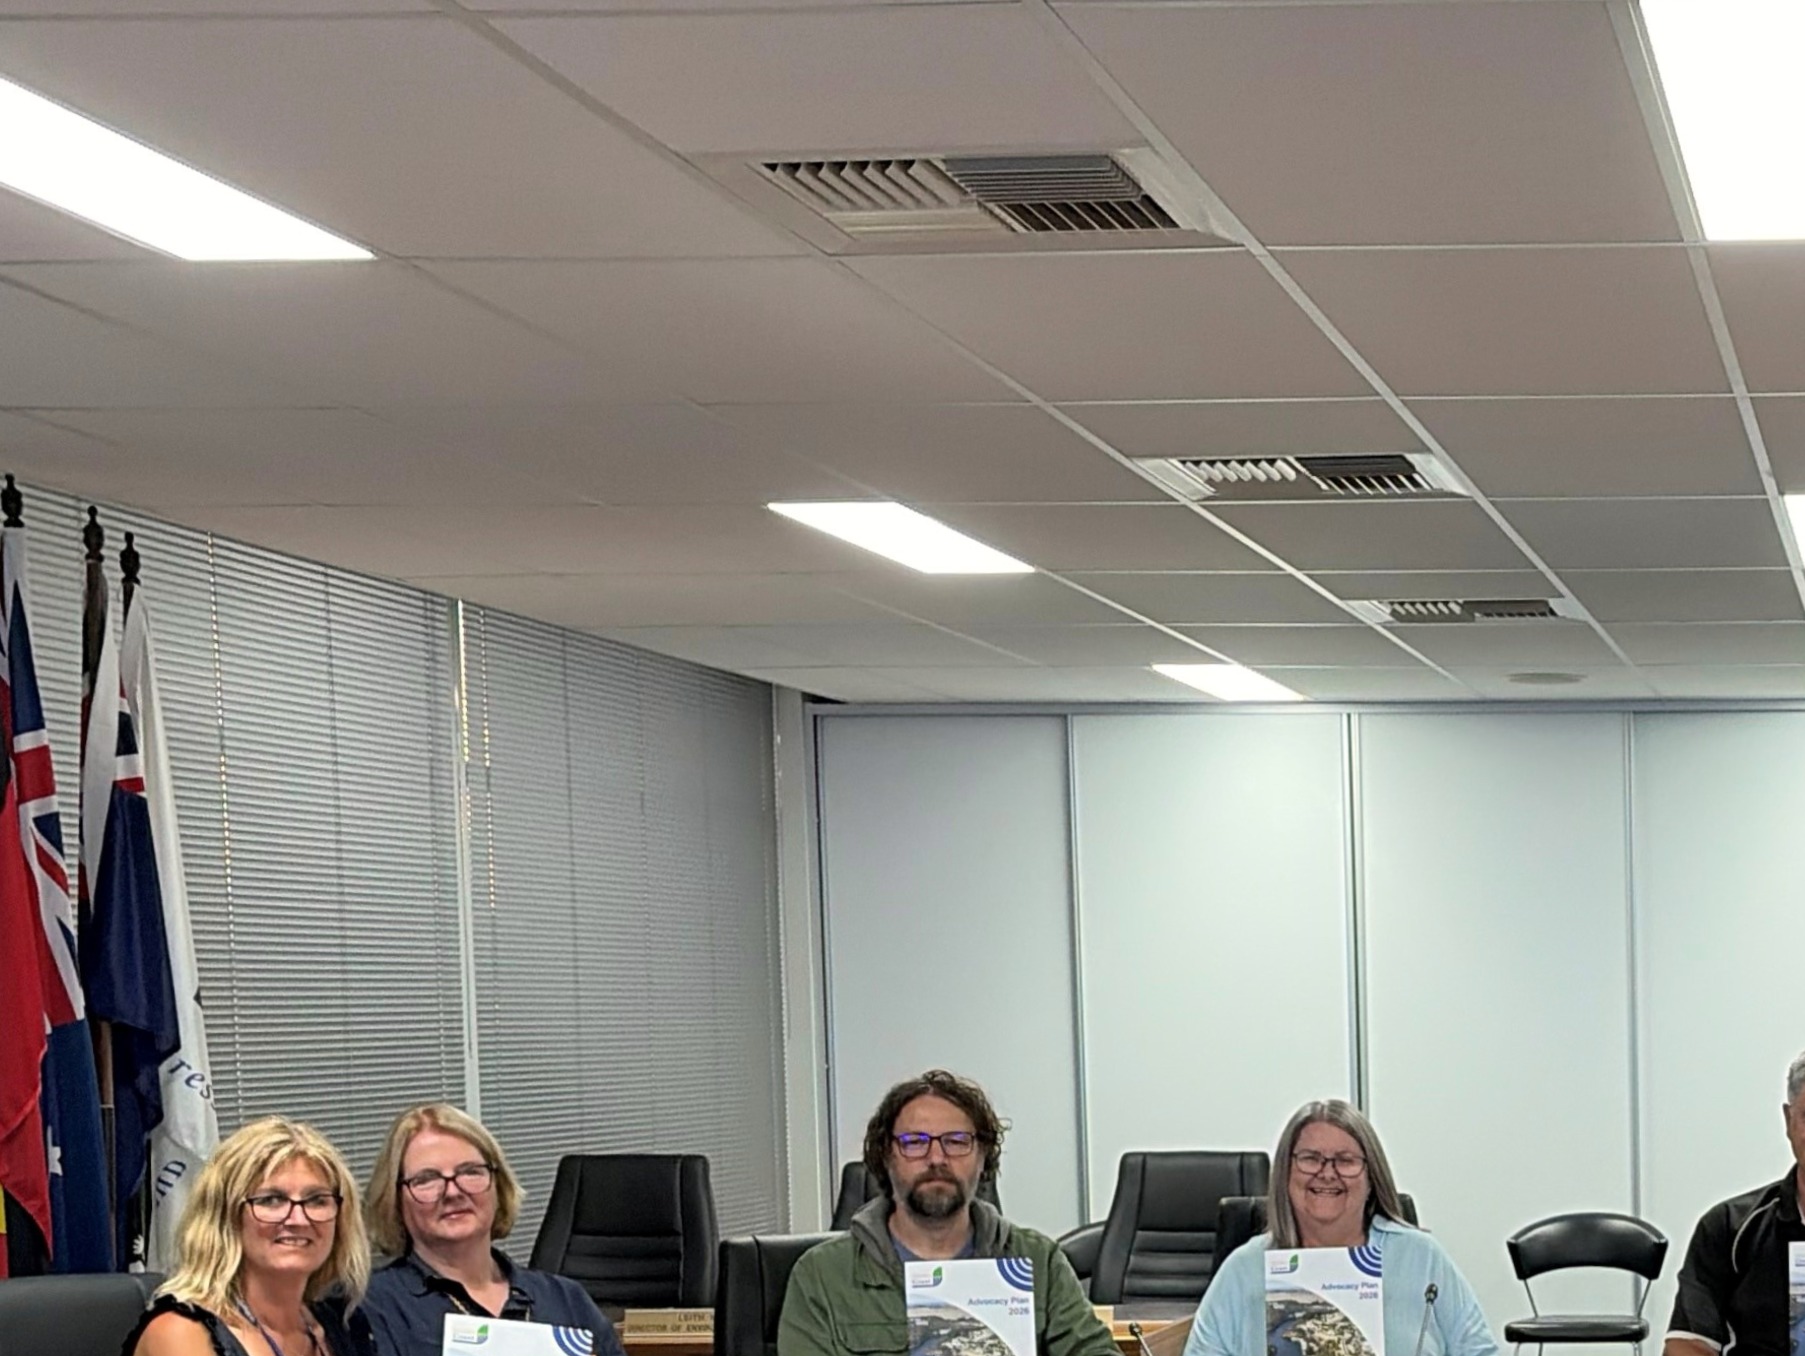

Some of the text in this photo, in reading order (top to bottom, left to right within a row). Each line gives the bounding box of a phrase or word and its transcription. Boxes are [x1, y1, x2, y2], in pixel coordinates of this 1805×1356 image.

[1321, 1281, 1378, 1291] Advocacy Plan
[1359, 1292, 1378, 1300] 2026
[968, 1296, 1029, 1307] Advocacy Plan
[1008, 1307, 1030, 1316] 2026
